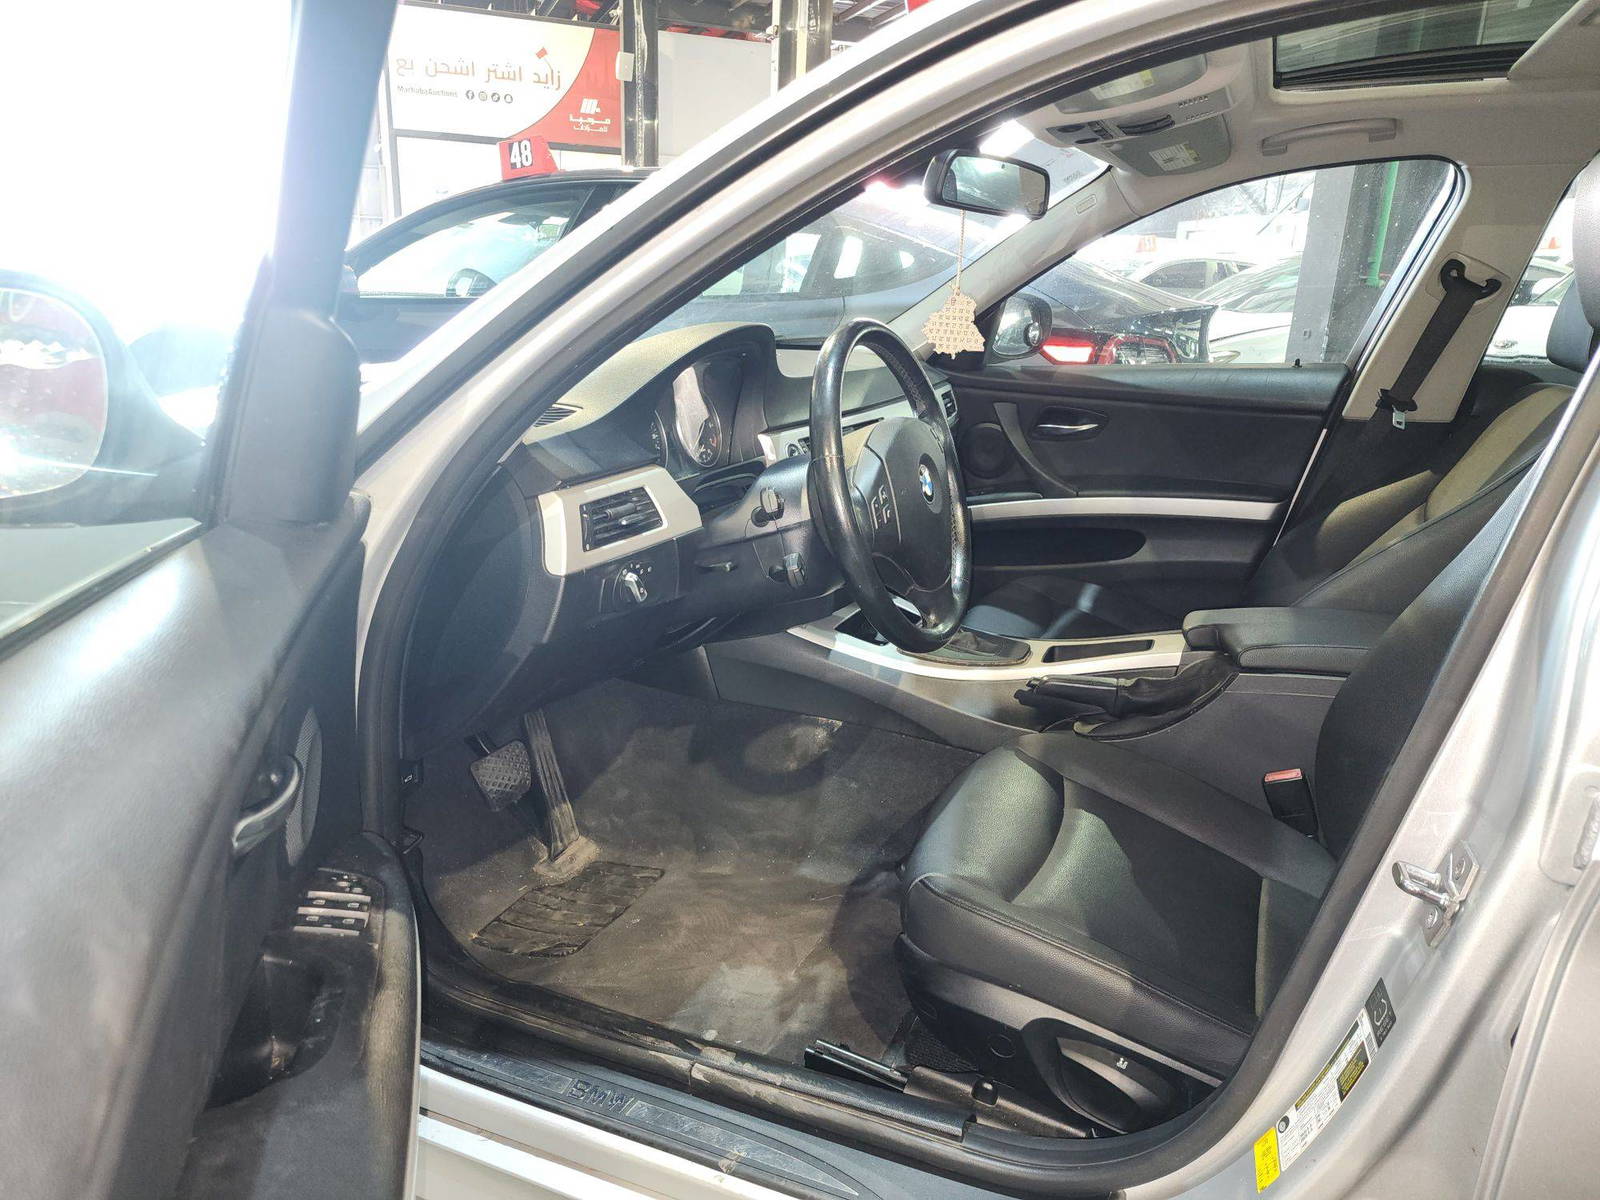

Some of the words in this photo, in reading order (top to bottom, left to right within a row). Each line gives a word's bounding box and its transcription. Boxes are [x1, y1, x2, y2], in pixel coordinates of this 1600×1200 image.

[485, 62, 523, 83] اشتر
[510, 139, 533, 169] 48
[567, 1079, 628, 1112] BMW
